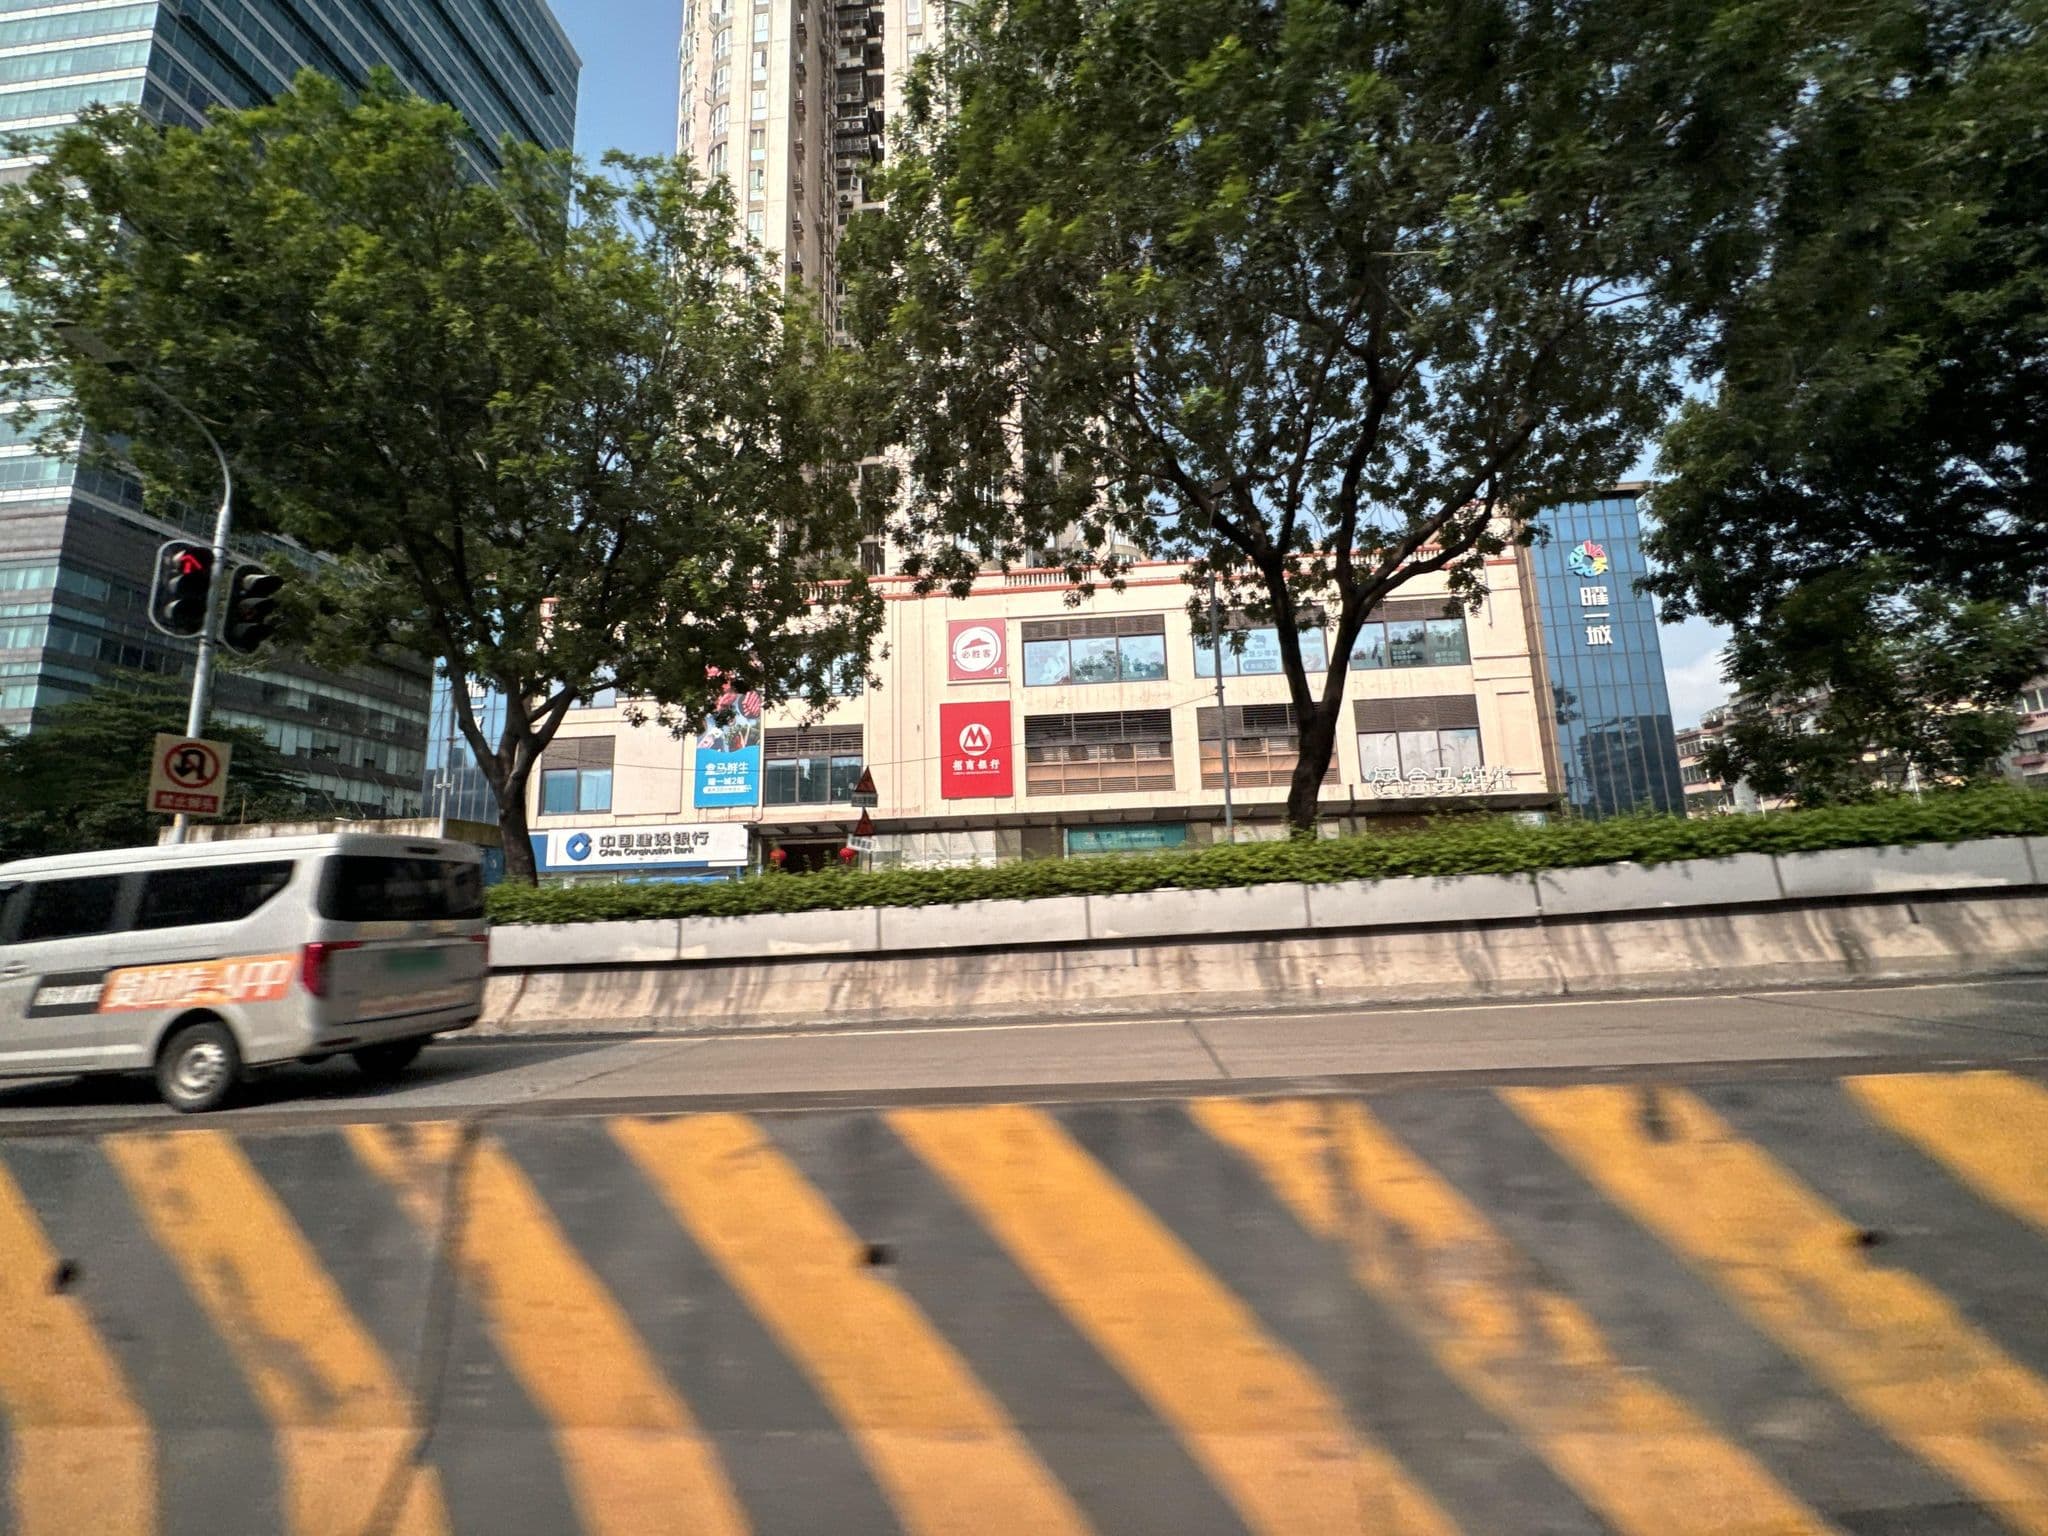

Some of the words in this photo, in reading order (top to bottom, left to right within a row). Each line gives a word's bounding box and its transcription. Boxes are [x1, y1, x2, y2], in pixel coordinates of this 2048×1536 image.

[961, 649, 991, 659] 必胜客
[993, 667, 1004, 675] 1F
[705, 761, 749, 775] 盒马鲜生
[952, 759, 1000, 770] 招商银行
[599, 831, 709, 848] 中国建设银行
[599, 848, 622, 857] China
[624, 847, 672, 857] Construction
[674, 846, 695, 855] Bank
